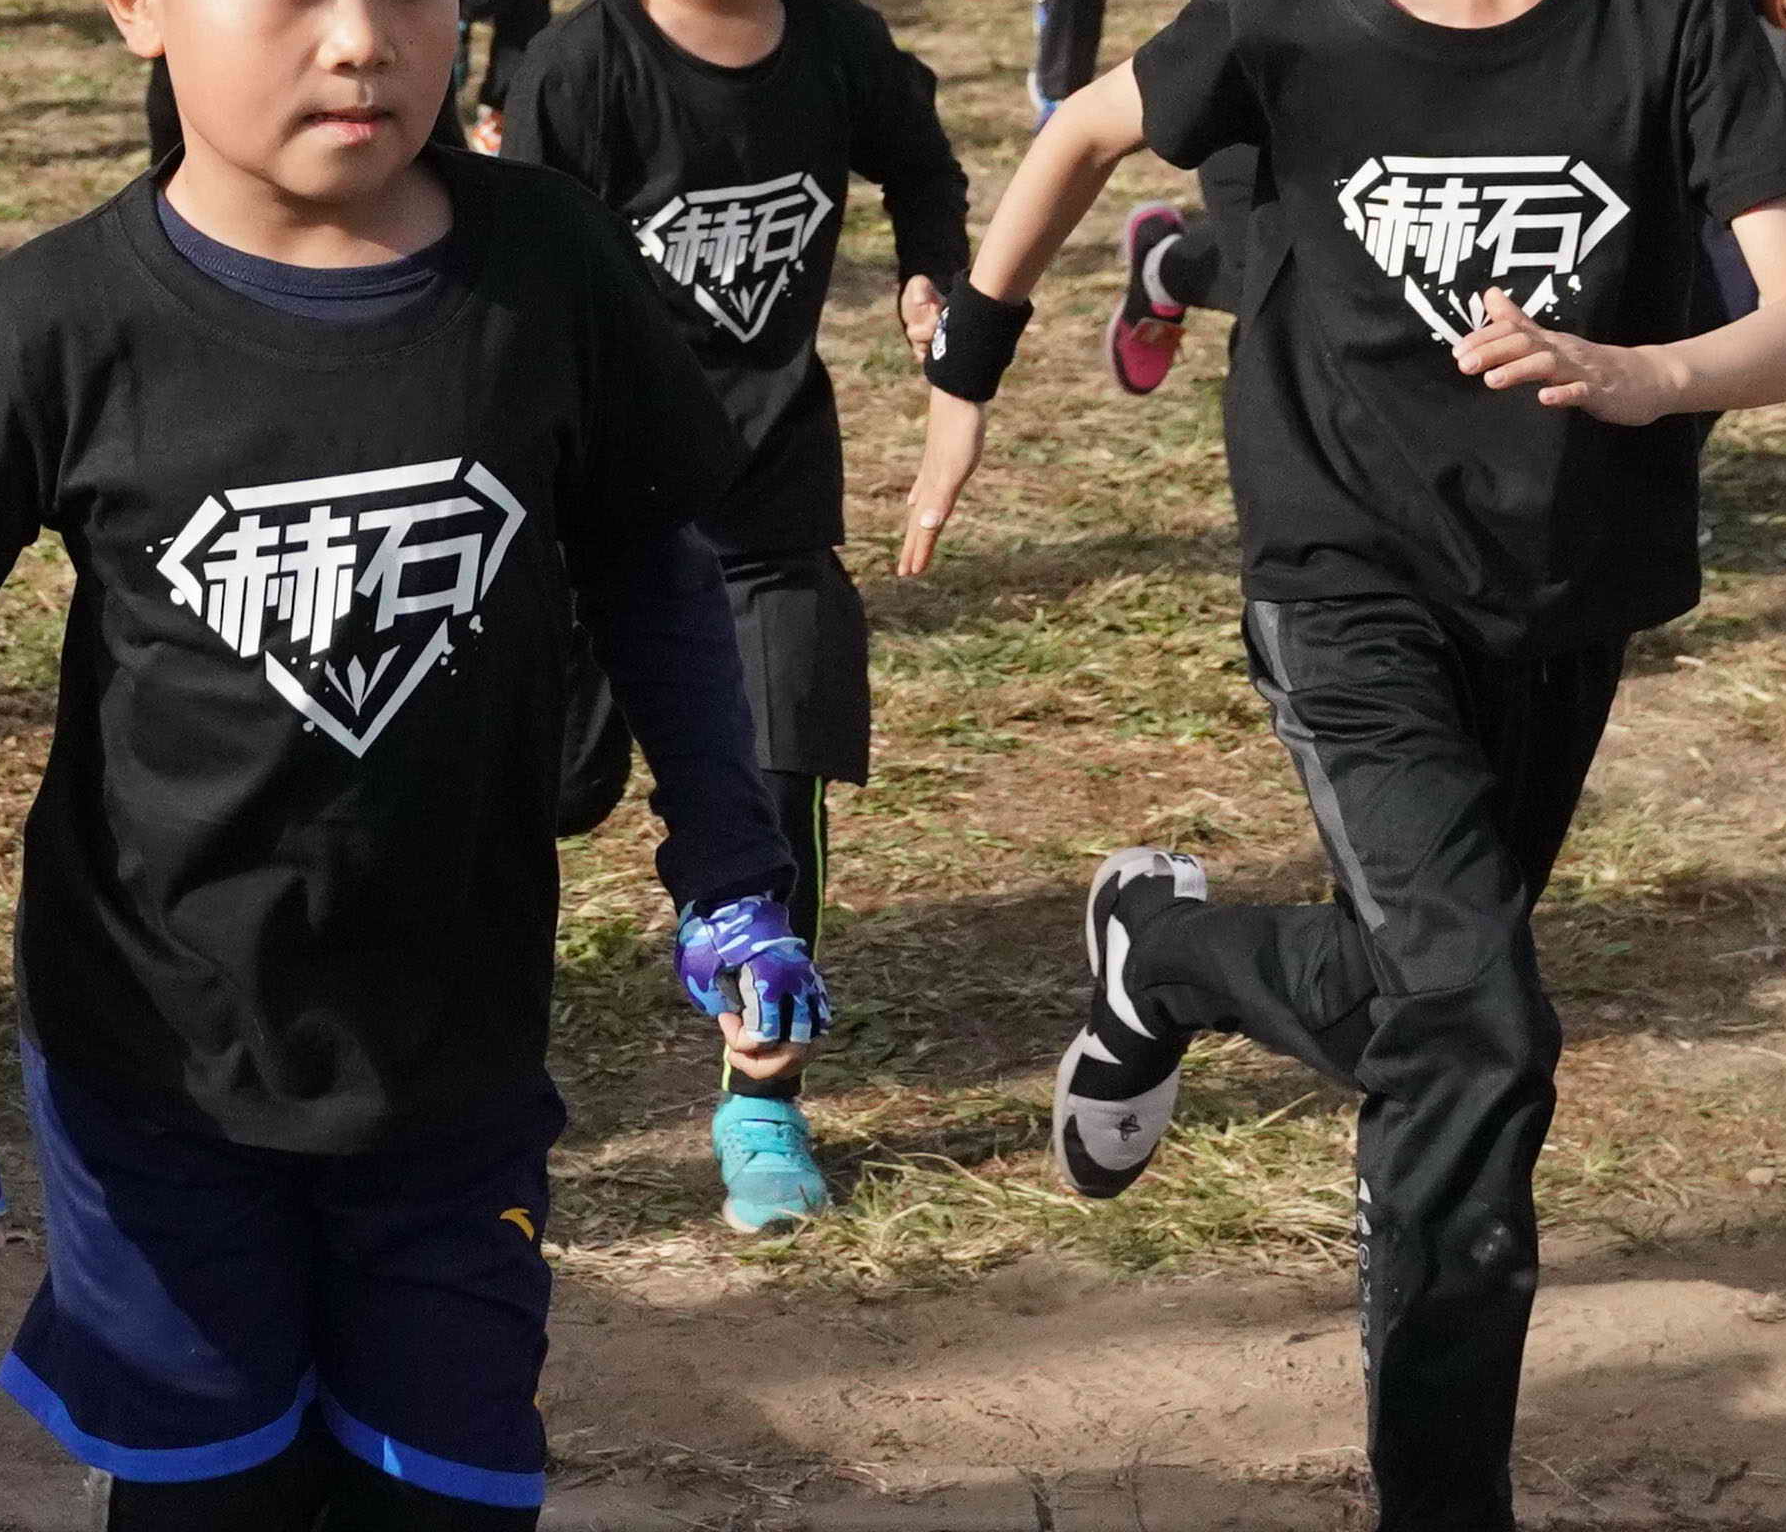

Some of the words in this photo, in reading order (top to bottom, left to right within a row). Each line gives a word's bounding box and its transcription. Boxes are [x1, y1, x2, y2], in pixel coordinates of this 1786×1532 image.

[663, 193, 808, 286] 赫石
[1364, 176, 1585, 286] 赫石
[203, 496, 485, 659] 赫石
